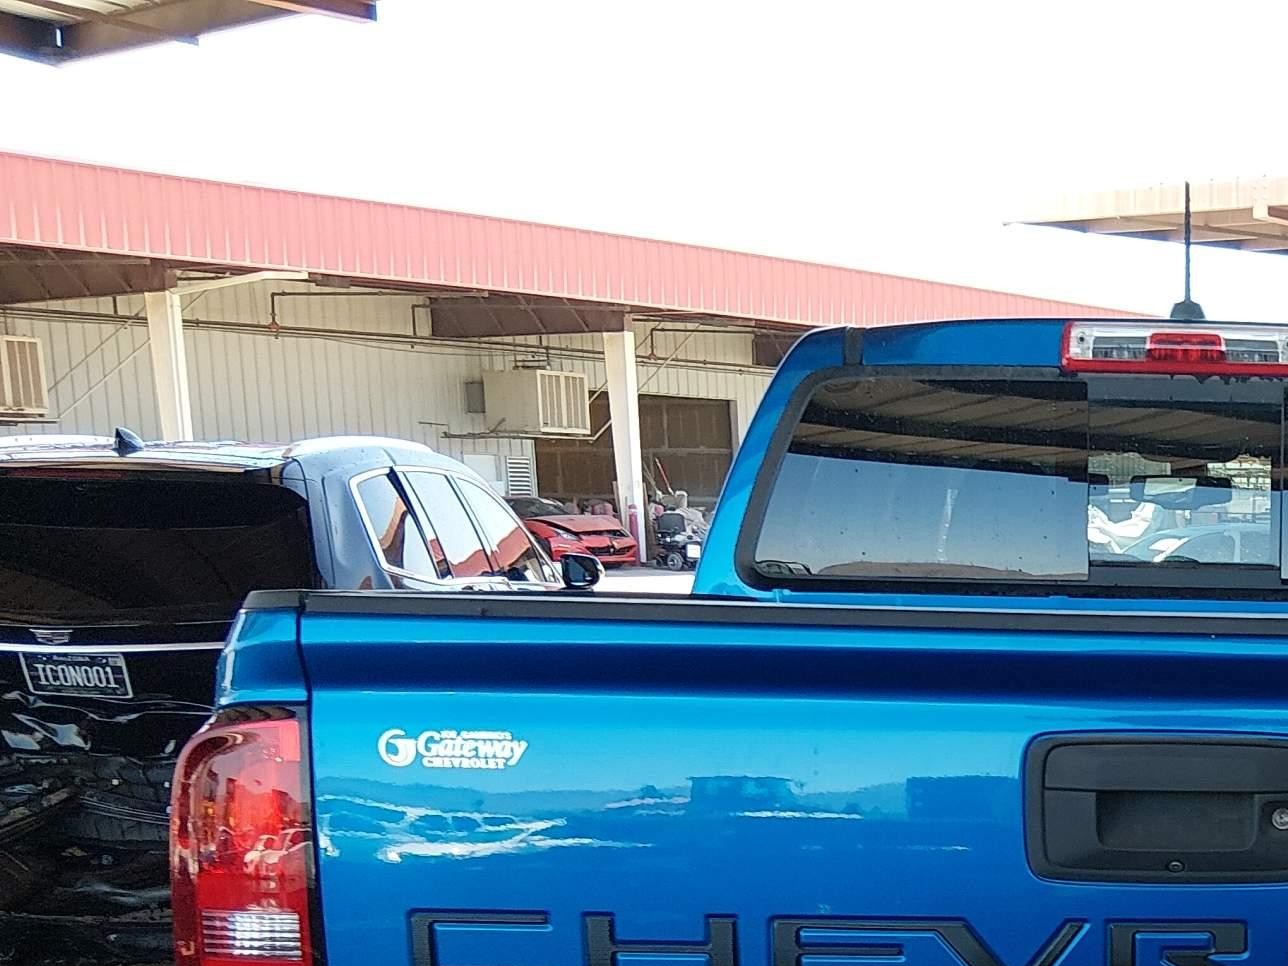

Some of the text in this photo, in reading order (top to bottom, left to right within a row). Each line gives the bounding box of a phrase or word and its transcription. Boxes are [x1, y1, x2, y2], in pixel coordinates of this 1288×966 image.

[33, 664, 119, 688] ICON001
[418, 731, 528, 766] Gateway
[423, 757, 506, 769] CHEVROLET
